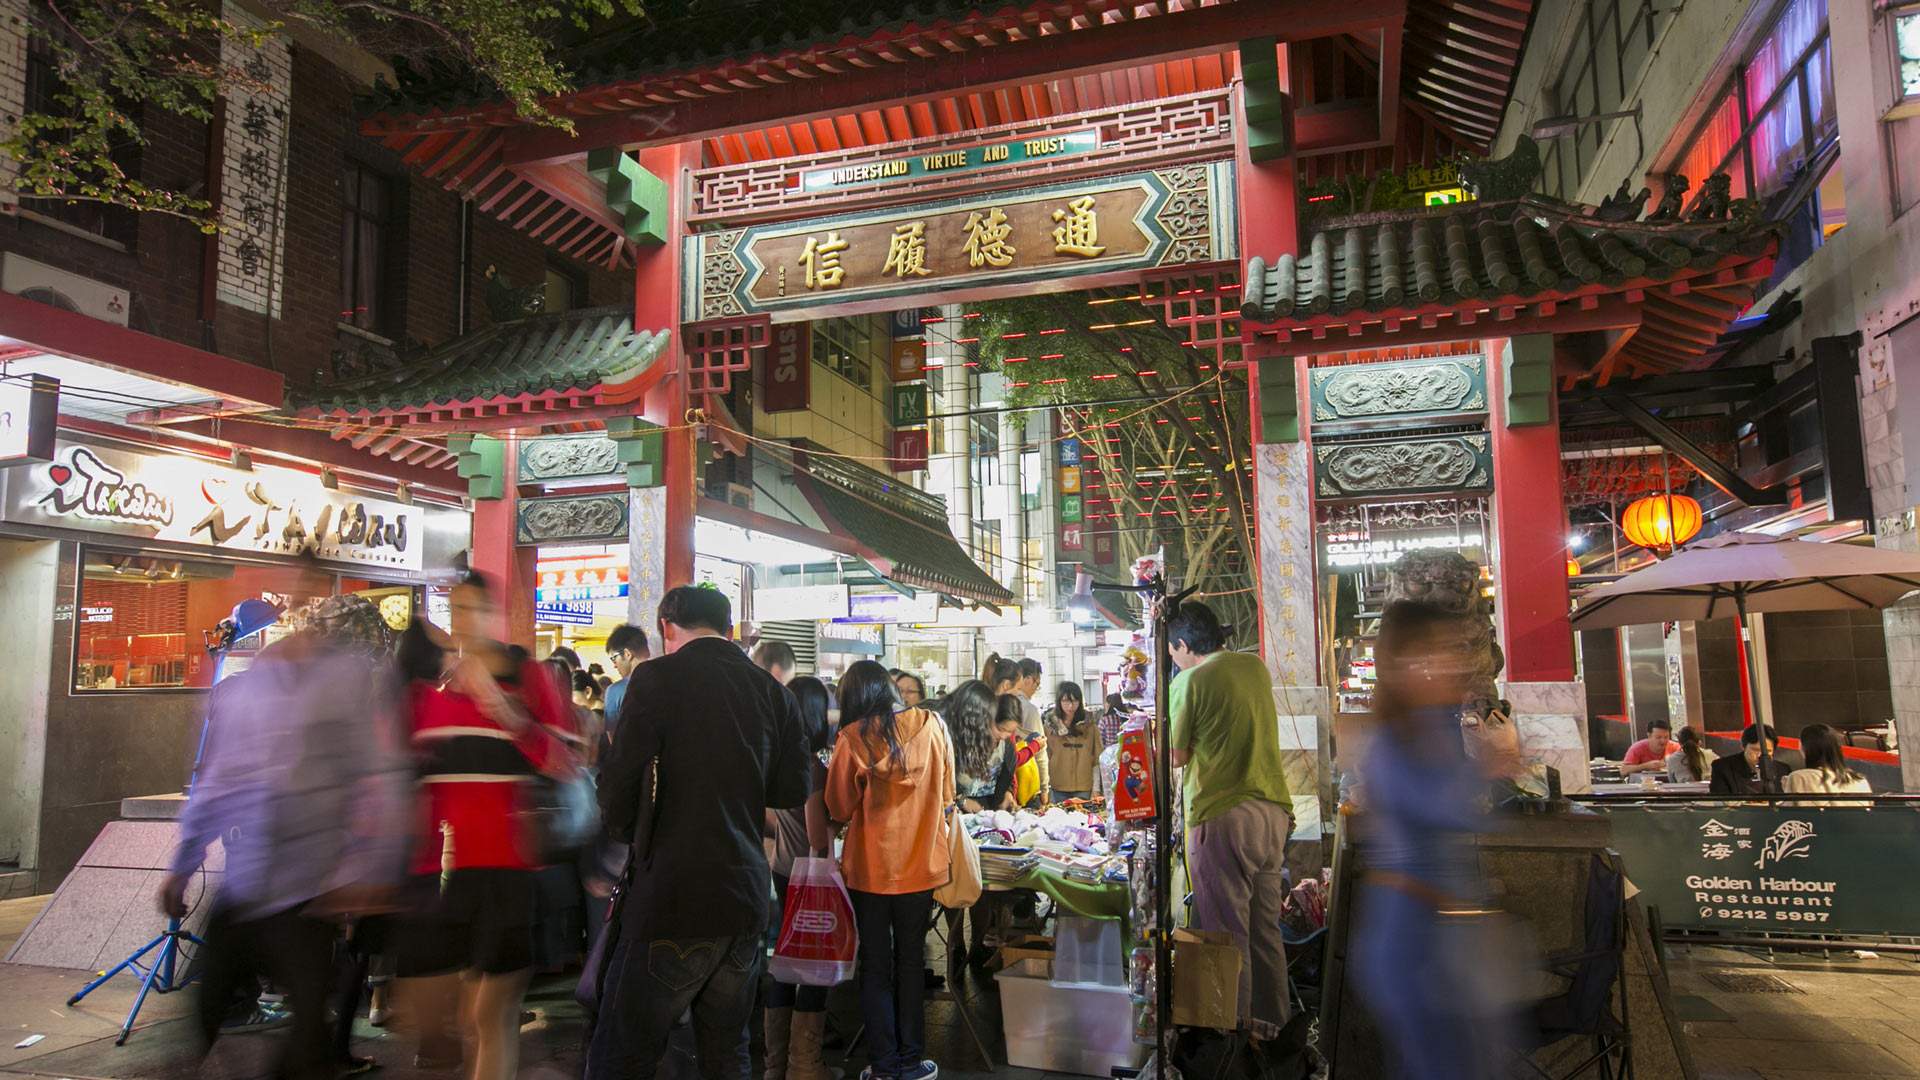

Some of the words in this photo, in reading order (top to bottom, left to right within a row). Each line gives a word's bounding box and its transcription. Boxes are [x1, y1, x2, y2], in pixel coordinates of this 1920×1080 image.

[831, 161, 908, 185] UNDERSTAND
[922, 150, 966, 170] VIRTUE
[983, 144, 1009, 162] AND
[1024, 137, 1068, 156] TRUST
[774, 323, 798, 383] Sus
[253, 539, 340, 556] Taiwaese
[1700, 818, 1734, 860] 金海
[1685, 875, 1752, 890] Golden
[1759, 877, 1837, 893] Harbour
[1695, 892, 1833, 907] Restaurant
[1717, 909, 1767, 919] 9212
[1775, 911, 1830, 922] 5987
